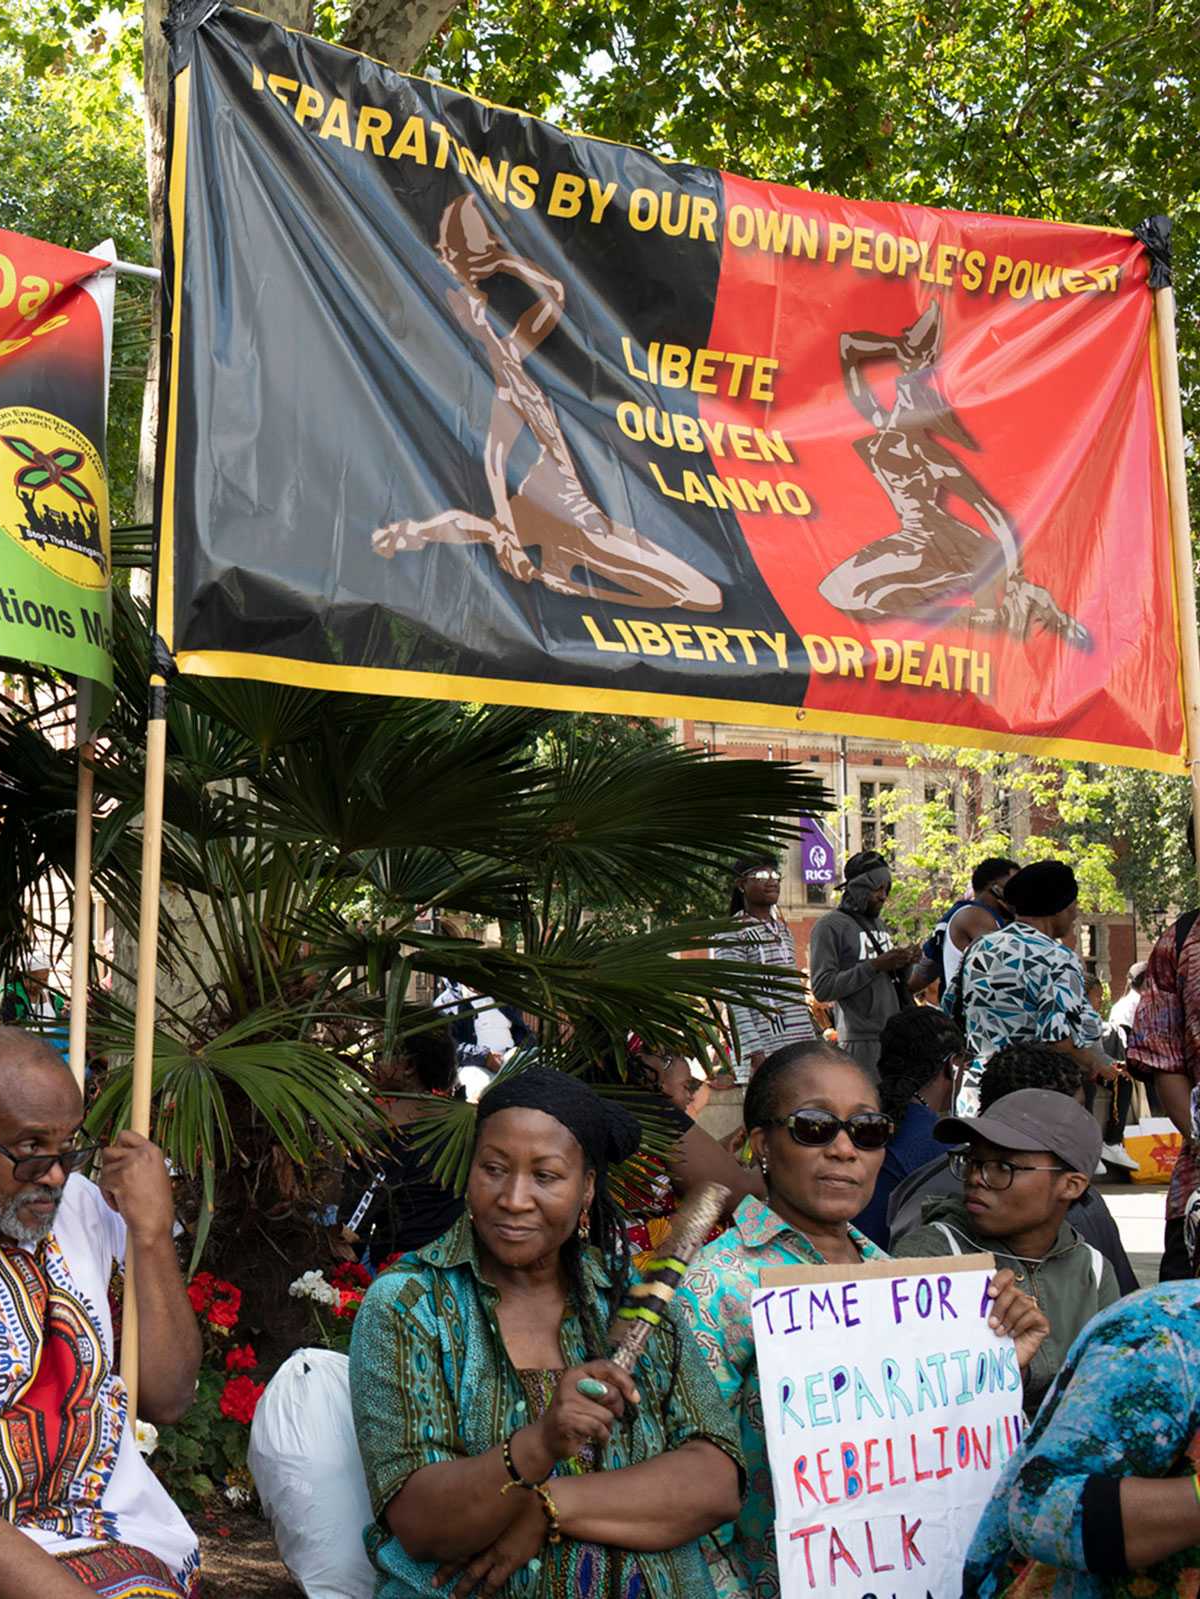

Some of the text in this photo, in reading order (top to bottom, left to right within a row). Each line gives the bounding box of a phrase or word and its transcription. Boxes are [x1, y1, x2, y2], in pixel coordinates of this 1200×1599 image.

[547, 173, 618, 224] BY
[628, 188, 718, 243] OUR
[727, 204, 818, 260] OWN
[826, 222, 986, 293] PEOPLE'S
[989, 254, 1121, 302] POWER
[621, 336, 779, 402] LIBETE
[615, 401, 794, 464] OUBYEN
[648, 461, 812, 516] LANMO
[581, 614, 992, 697] LIBERTY OR DEATH
[804, 868, 834, 881] RICS
[752, 1282, 862, 1335] TIME
[891, 1275, 959, 1325] FOR
[776, 1346, 1022, 1435] REPARATIONS
[789, 1514, 926, 1589] TALK
